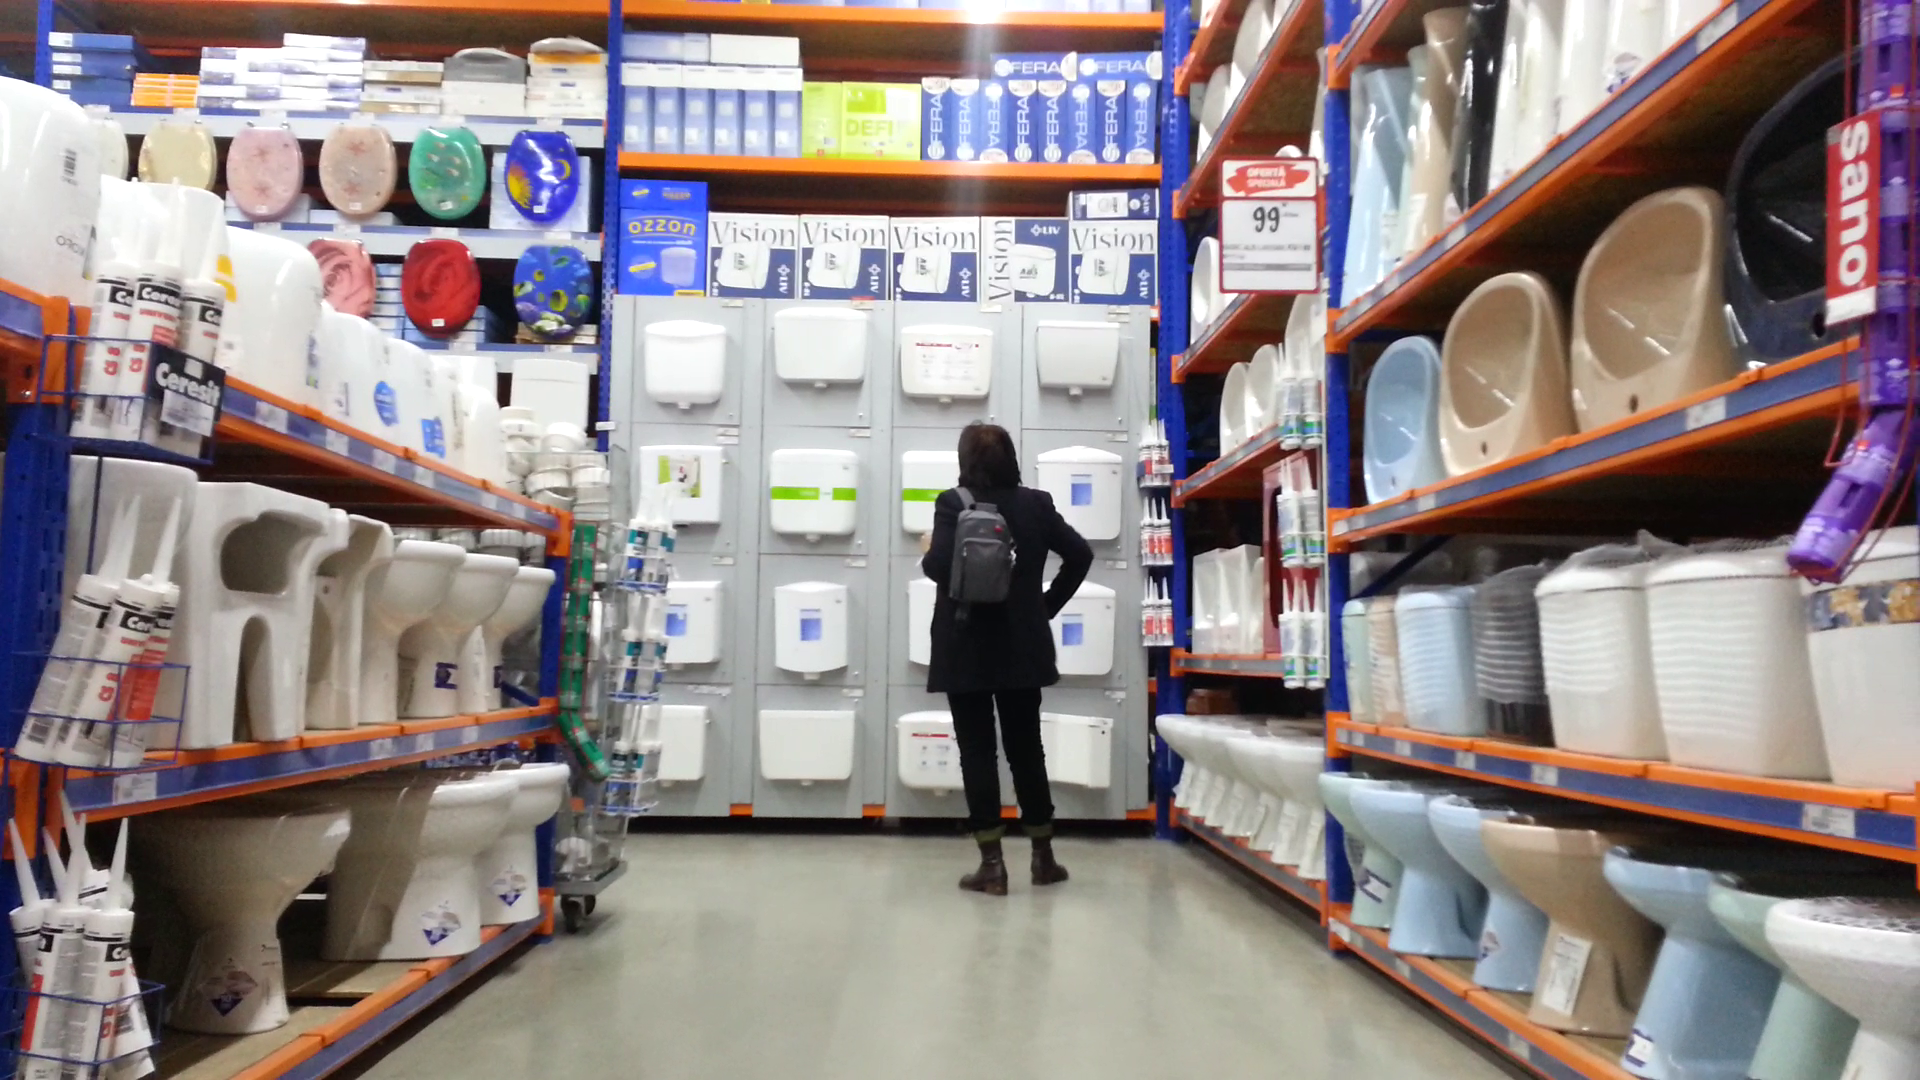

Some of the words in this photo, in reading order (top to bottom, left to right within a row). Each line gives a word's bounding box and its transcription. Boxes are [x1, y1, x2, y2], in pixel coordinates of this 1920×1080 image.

[1080, 58, 1146, 76] FERA
[957, 96, 974, 160] FERA
[985, 83, 1003, 147] FERA
[1072, 84, 1090, 149] FERA
[1133, 83, 1151, 147] FERA
[1839, 120, 1870, 286] sano
[628, 219, 697, 237] ozzon
[1043, 226, 1061, 236] LIV
[1253, 206, 1280, 232] 99
[711, 221, 796, 247] Vision
[803, 221, 886, 248] Vision
[893, 225, 977, 250] Vision
[1072, 227, 1155, 252] Vision
[988, 219, 1013, 301] Vision
[155, 362, 220, 406] Ceresit
